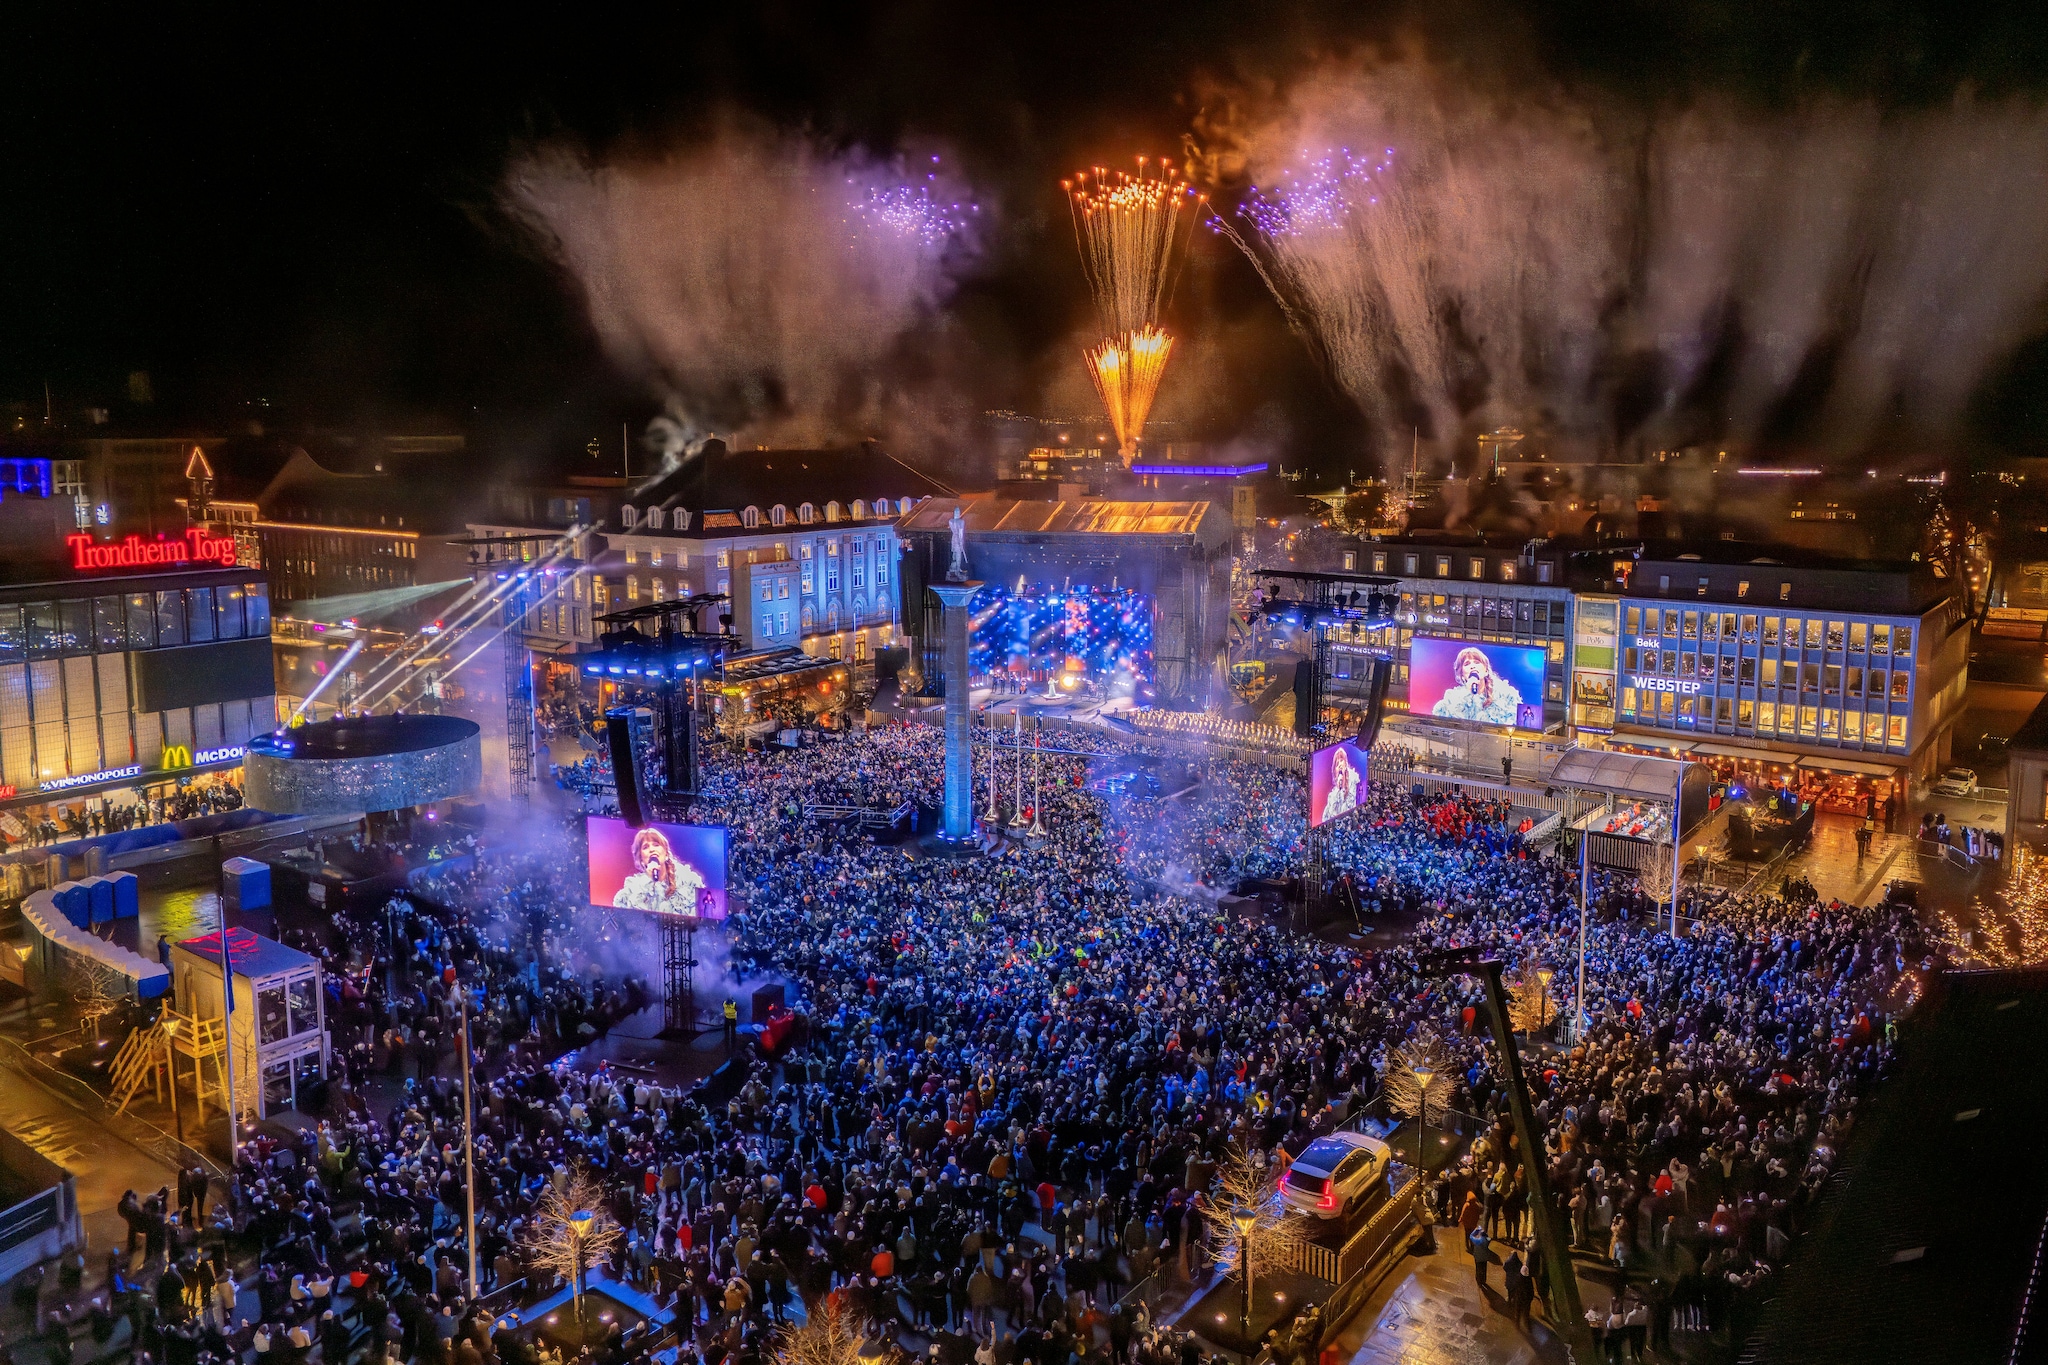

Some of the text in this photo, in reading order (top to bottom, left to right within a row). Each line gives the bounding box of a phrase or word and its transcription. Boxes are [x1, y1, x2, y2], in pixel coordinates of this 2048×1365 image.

[67, 528, 236, 569] Trondheim Torg
[1636, 638, 1660, 648] Bekk
[1631, 676, 1701, 694] WEBSTEP
[50, 766, 141, 788] VINMONOPOLET
